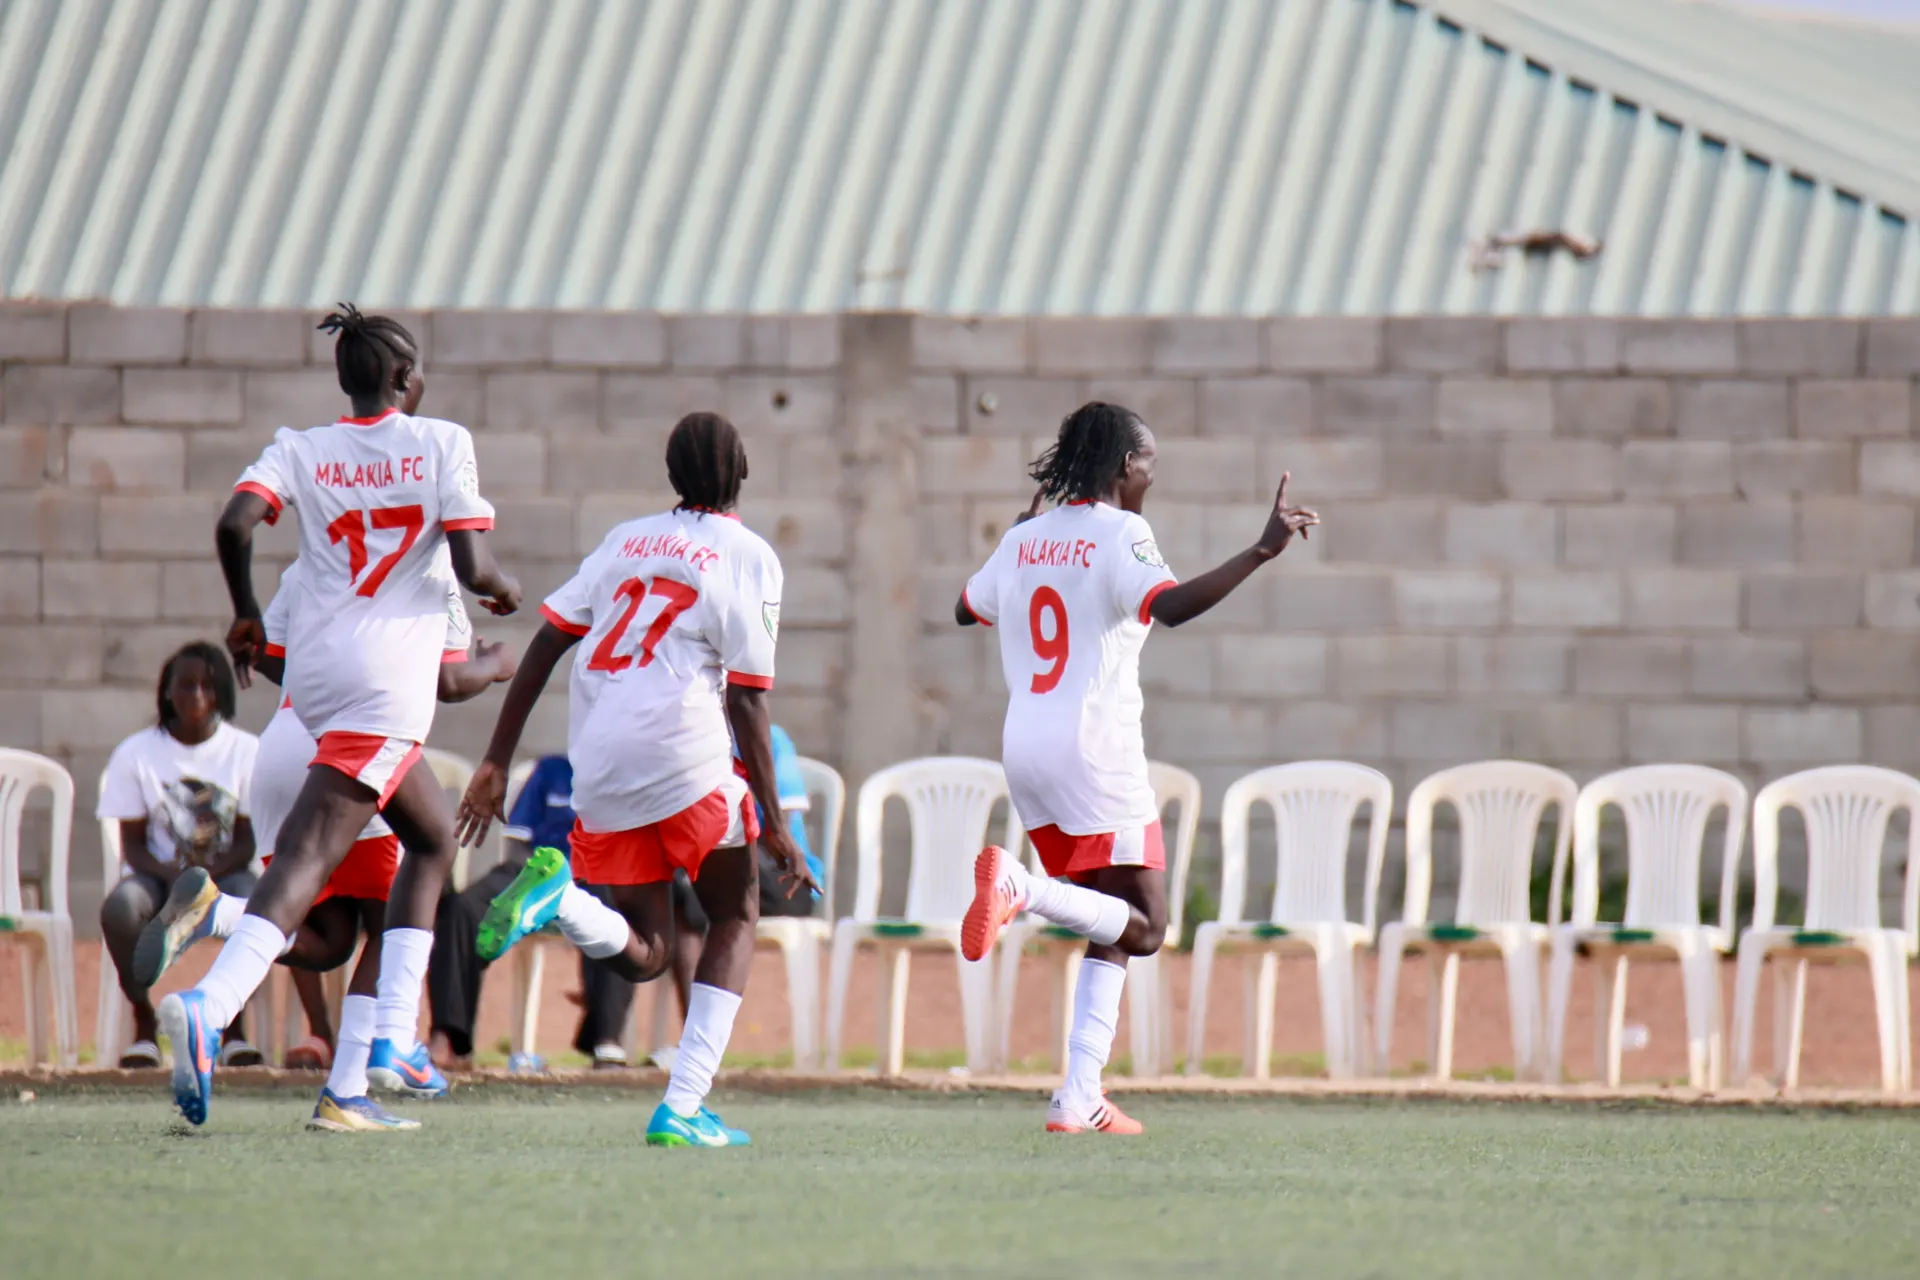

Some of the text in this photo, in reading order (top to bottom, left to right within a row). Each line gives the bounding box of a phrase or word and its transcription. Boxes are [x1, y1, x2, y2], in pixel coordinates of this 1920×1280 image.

[315, 456, 424, 489] MALAKIA FC
[326, 504, 425, 598] 17
[616, 534, 720, 572] MALAKIA FC
[1072, 538, 1097, 568] FC
[586, 575, 699, 675] 27
[1029, 585, 1070, 694] 9
